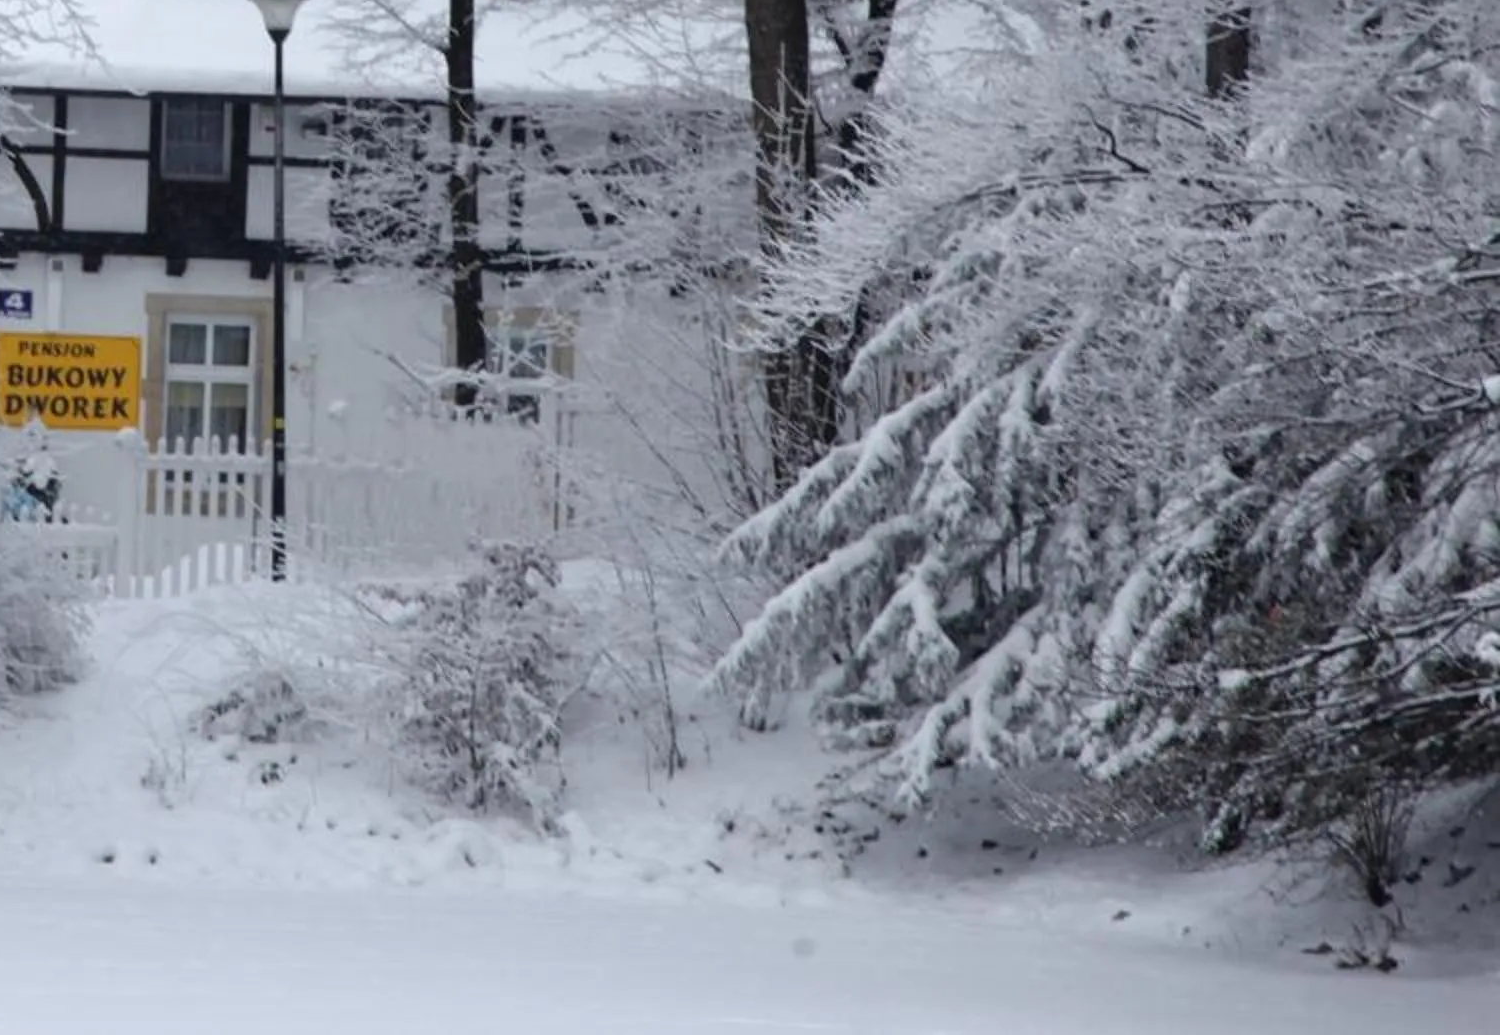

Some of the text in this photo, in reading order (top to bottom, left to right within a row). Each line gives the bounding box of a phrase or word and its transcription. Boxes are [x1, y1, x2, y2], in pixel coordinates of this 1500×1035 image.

[19, 341, 96, 357] PENSION
[8, 364, 127, 388] BUKOWY
[5, 395, 130, 419] DWOREK
